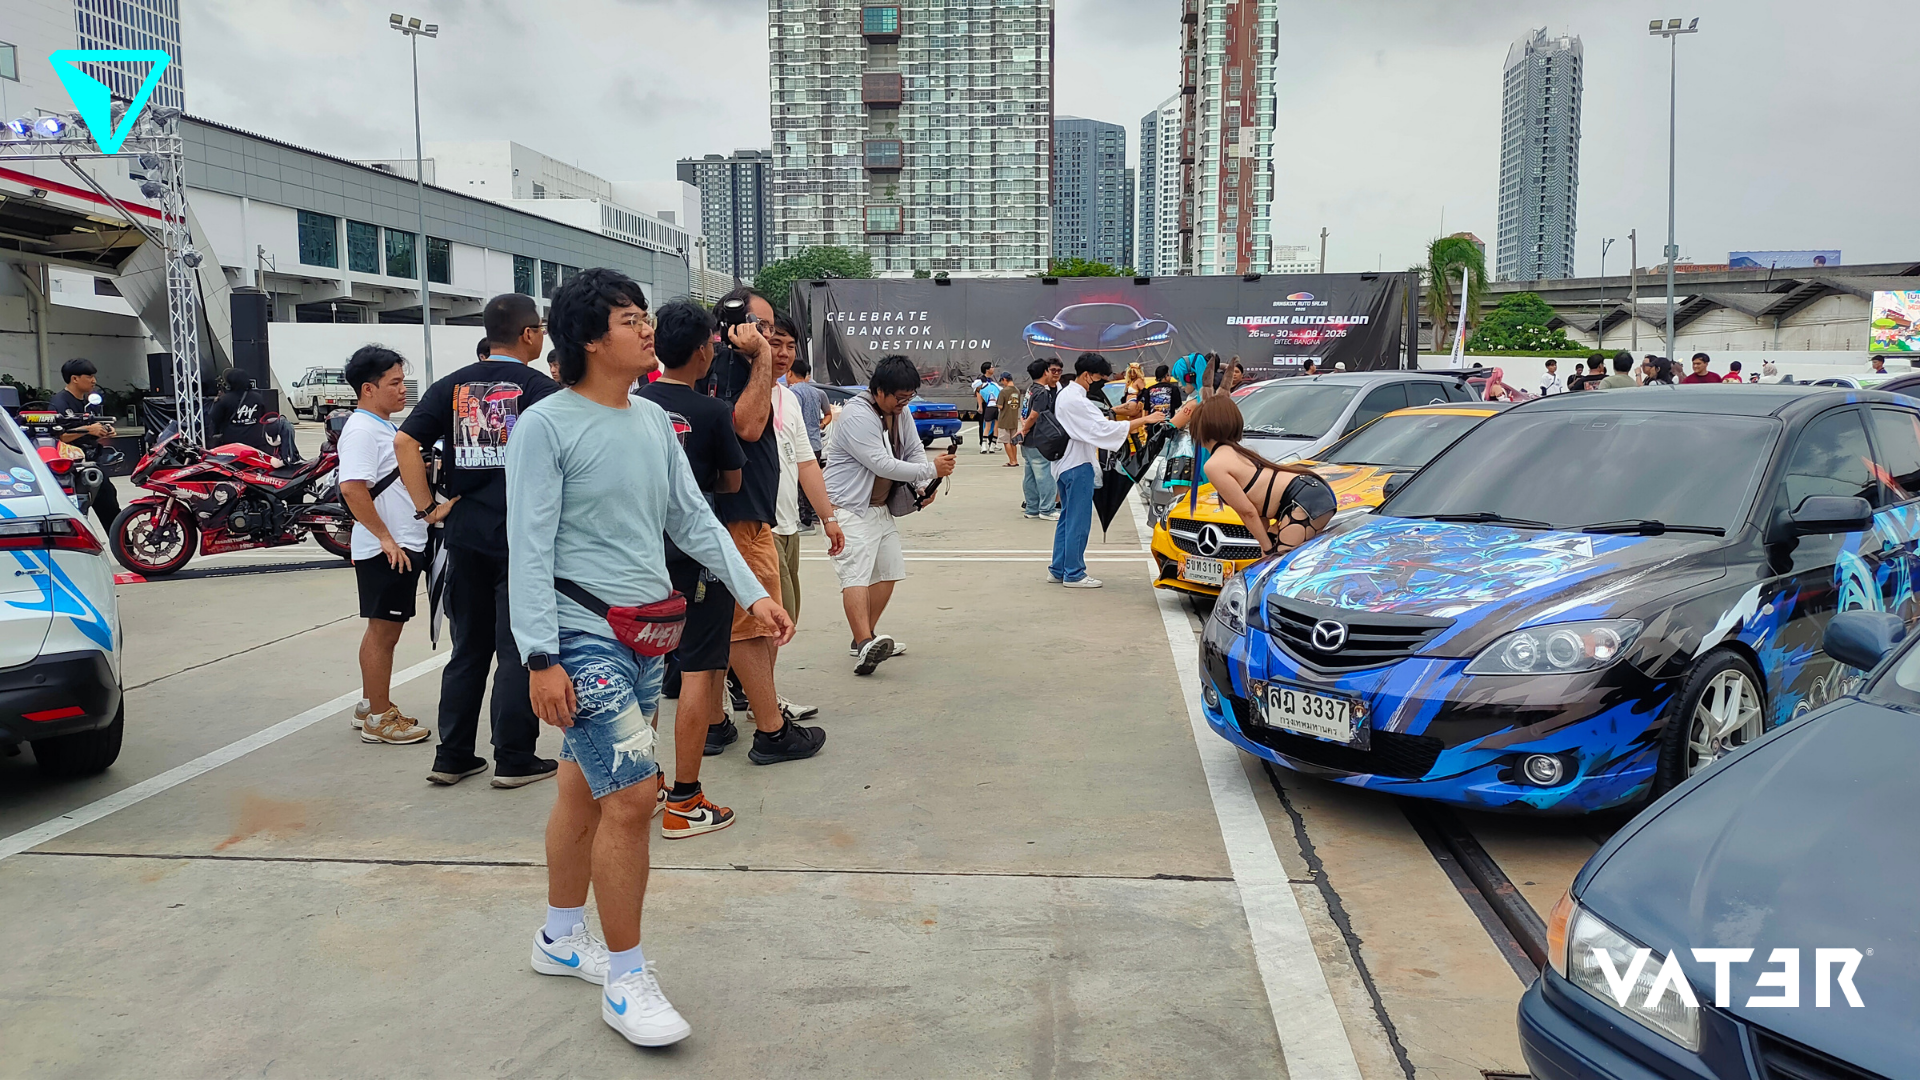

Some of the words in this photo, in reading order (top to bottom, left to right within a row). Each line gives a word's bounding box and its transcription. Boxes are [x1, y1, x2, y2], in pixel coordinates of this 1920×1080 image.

[826, 311, 929, 322] CELEBRATE
[1226, 316, 1289, 325] BANGKOK
[1291, 316, 1326, 325] AUTO
[1327, 316, 1370, 325] SALON
[847, 325, 932, 336] BANGKOK
[1248, 329, 1260, 338] 26
[1276, 329, 1289, 338] 30
[1305, 329, 1318, 338] 08
[1325, 329, 1347, 338] 2026
[869, 339, 991, 351] DESTINATION
[1274, 338, 1293, 346] BITEC
[1293, 338, 1321, 346] BANGNA
[1302, 694, 1347, 723] 3337
[1279, 716, 1338, 736] กรุงเทพมหานคร
